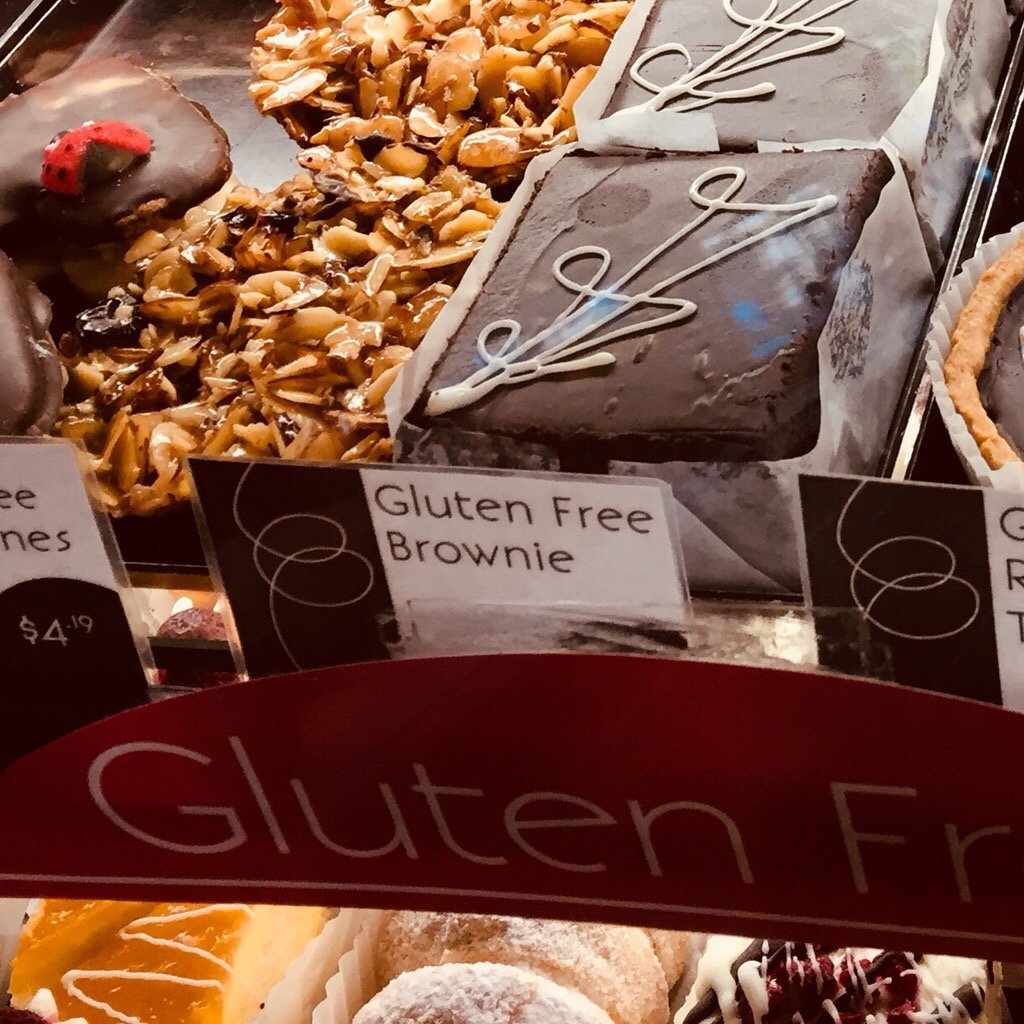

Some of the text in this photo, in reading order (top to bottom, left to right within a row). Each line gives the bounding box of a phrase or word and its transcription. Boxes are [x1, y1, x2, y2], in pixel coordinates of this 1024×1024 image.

[374, 484, 653, 534] Gluten Free
[386, 530, 574, 573] Brownie
[19, 614, 93, 647] $4.19
[87, 736, 755, 884] Gluten
